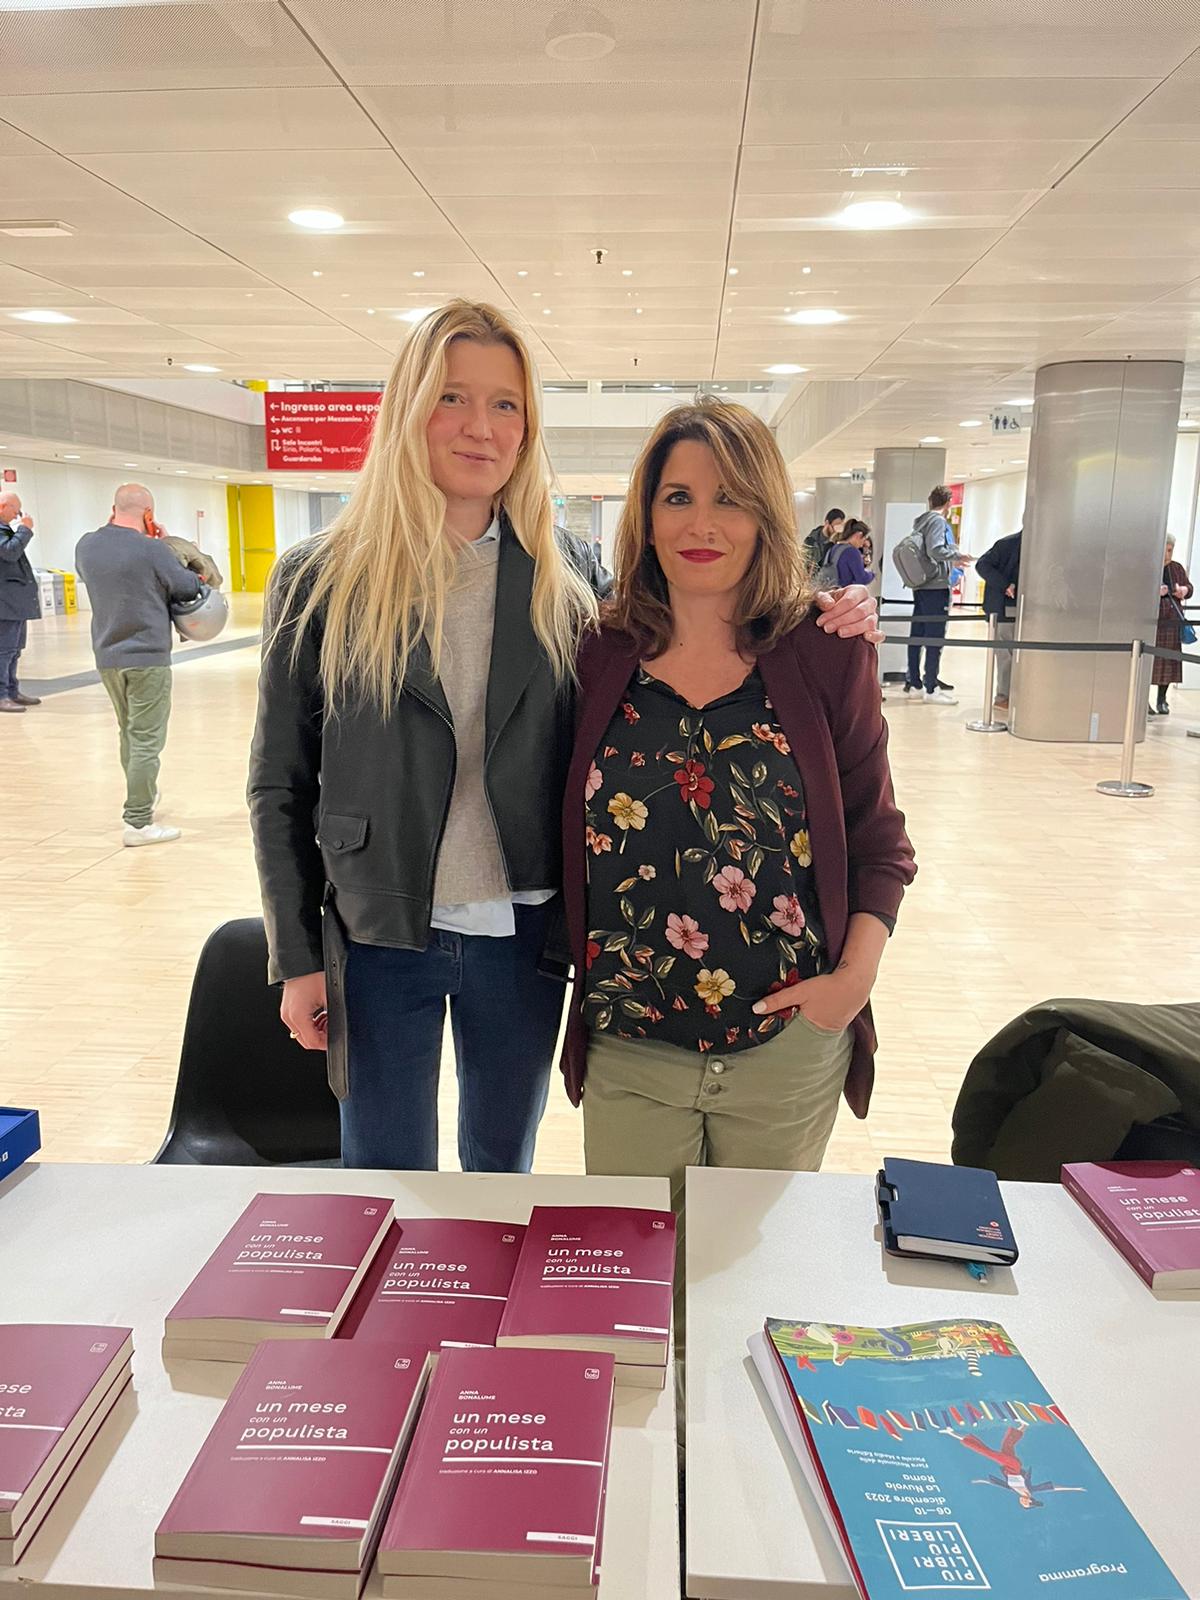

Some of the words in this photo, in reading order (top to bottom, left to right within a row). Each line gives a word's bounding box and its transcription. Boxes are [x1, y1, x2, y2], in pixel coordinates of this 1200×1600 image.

[281, 402, 326, 414] Ingresso
[1143, 1196, 1188, 1204] mese
[250, 1234, 272, 1242] un
[276, 1235, 324, 1243] mese
[237, 1249, 323, 1260] populista
[575, 1249, 624, 1257] mese
[393, 1262, 414, 1270] un
[419, 1263, 468, 1272] mese
[543, 1263, 631, 1275] populista
[384, 1278, 471, 1290] populista
[256, 1403, 282, 1413] un
[288, 1403, 347, 1413] mese
[453, 1413, 480, 1423] un
[486, 1413, 546, 1424] mese
[240, 1425, 348, 1441] populista
[444, 1436, 553, 1453] populista
[877, 1459, 910, 1468] Nazionale
[902, 1474, 936, 1483] Roma
[885, 1482, 925, 1493] Nuvola
[925, 1484, 941, 1492] La
[864, 1492, 892, 1503] 2023
[893, 1495, 946, 1505] dicembre
[888, 1529, 955, 1542] LIBERI
[928, 1543, 962, 1556] PIÙ
[913, 1556, 969, 1568] LIBRI
[941, 1569, 975, 1582] PIÙ
[1038, 1562, 1128, 1582] Programma
